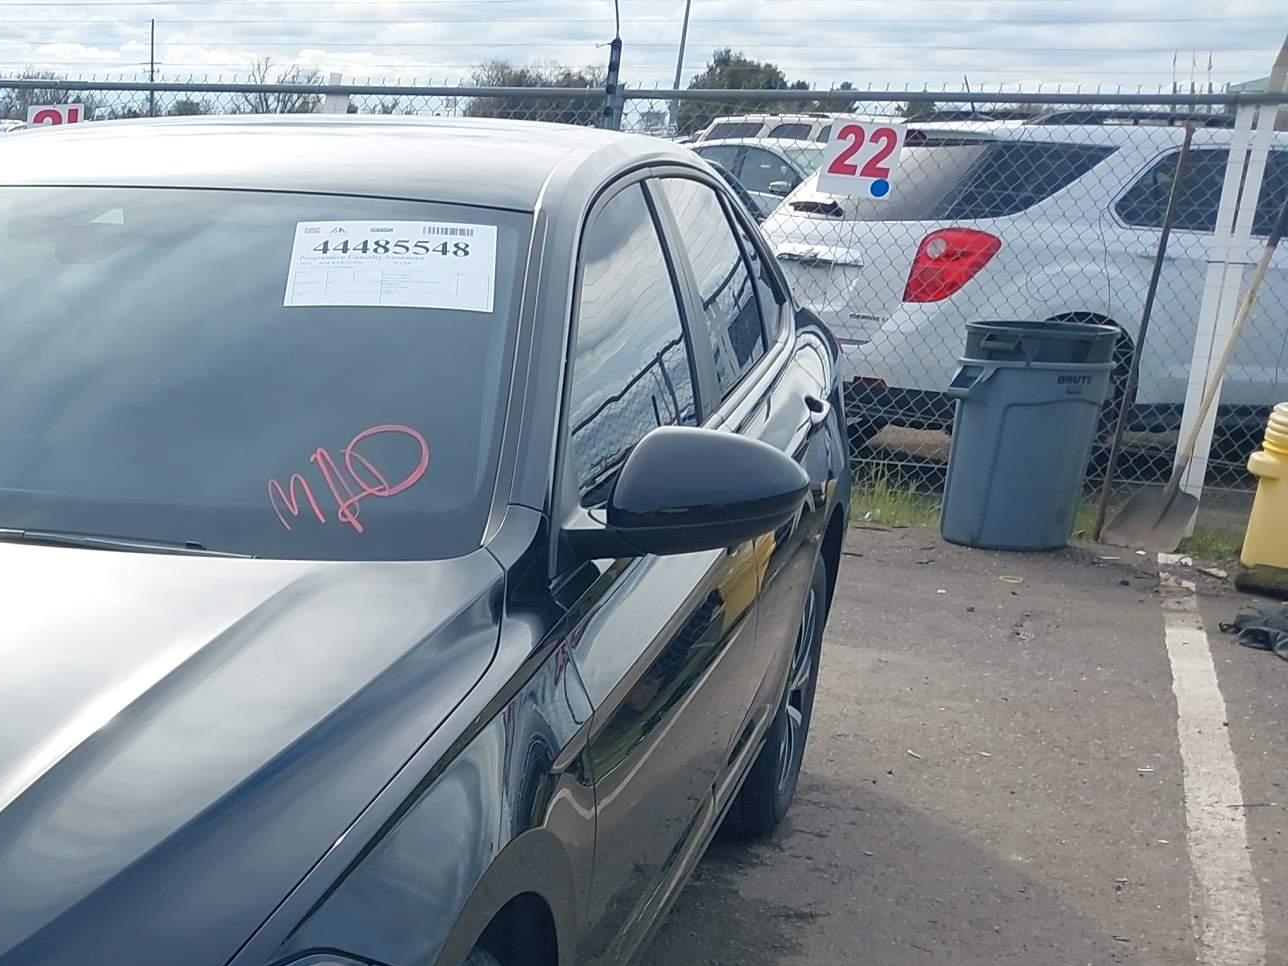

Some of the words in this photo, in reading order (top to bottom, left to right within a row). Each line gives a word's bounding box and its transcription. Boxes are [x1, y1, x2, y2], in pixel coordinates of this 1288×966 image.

[827, 124, 898, 179] 22
[313, 239, 470, 257] 44485548
[1057, 375, 1093, 385] BRUTE
